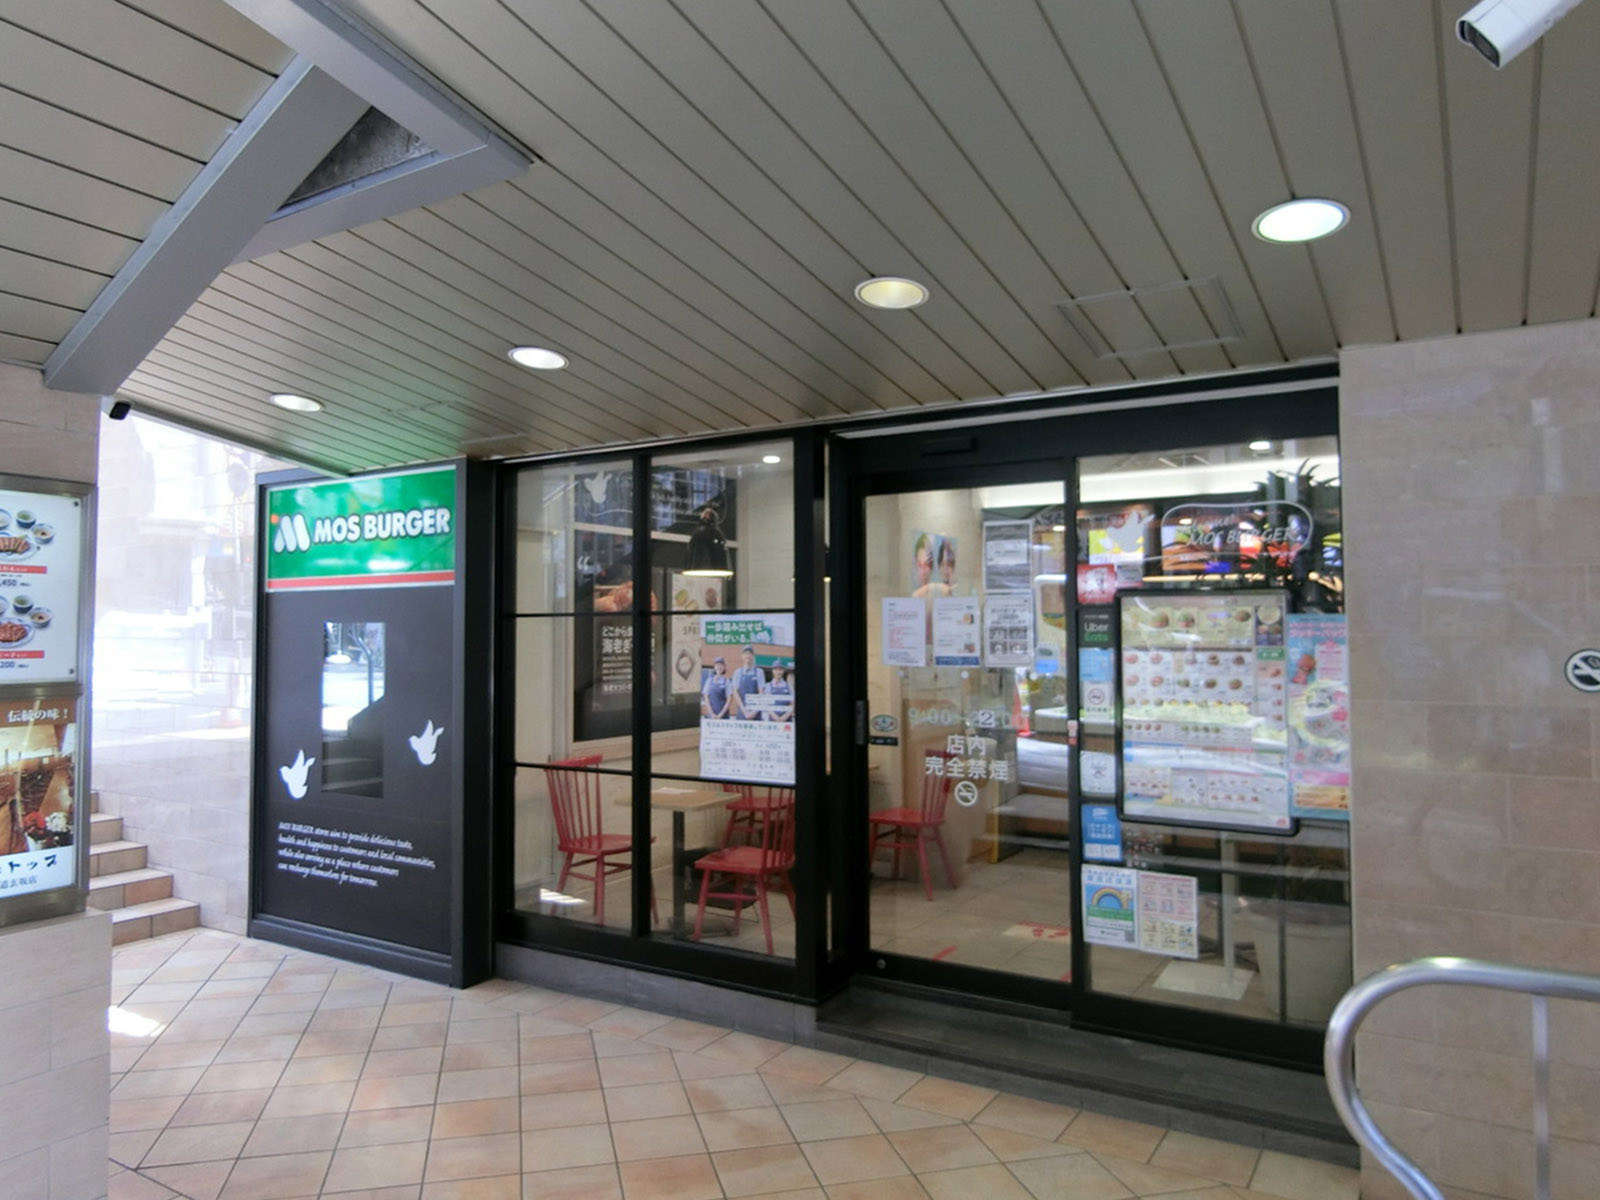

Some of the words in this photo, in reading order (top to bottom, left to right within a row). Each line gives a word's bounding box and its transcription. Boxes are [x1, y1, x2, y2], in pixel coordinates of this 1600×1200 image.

[314, 516, 360, 543] MOS
[364, 508, 450, 540] BURGER
[1084, 622, 1109, 632] Uber
[1084, 632, 1108, 641] Eats
[946, 734, 986, 756] 店内
[925, 756, 1009, 781] 完全禁煙
